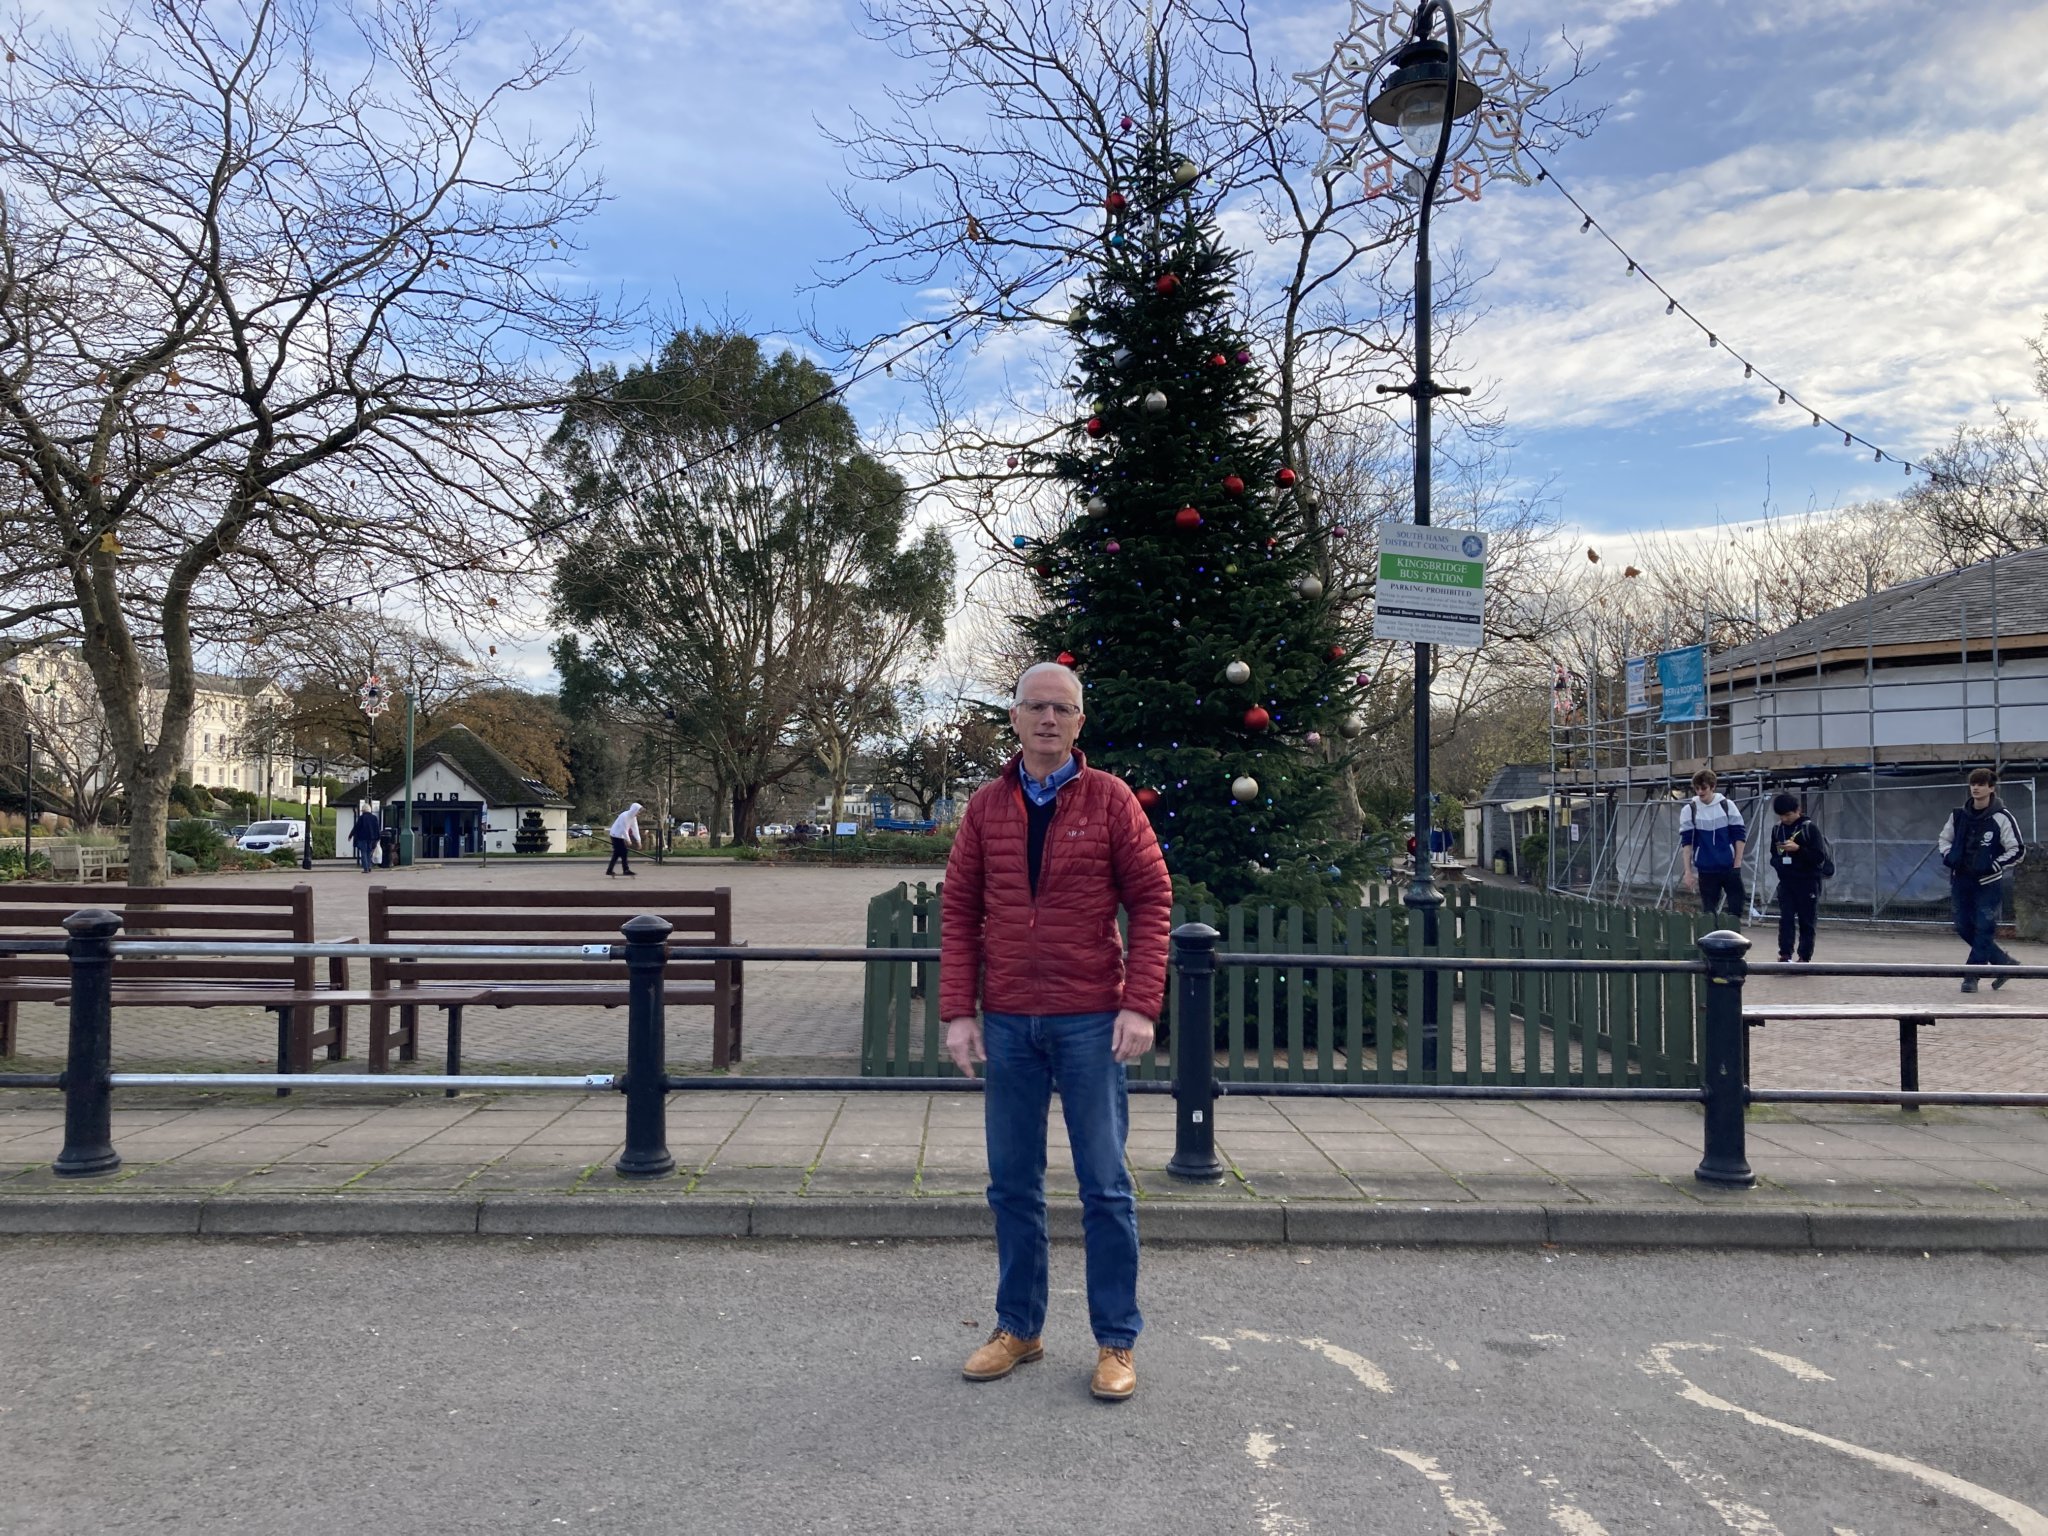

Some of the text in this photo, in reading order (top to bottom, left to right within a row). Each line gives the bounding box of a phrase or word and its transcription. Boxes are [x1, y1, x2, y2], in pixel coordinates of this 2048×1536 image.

[1397, 531, 1449, 543] SOUTH HAMS
[1385, 539, 1459, 552] DISTRICT COUNCIL
[1397, 558, 1468, 573] KINGSBRIDGE
[1400, 569, 1463, 583] BUS STATION
[1391, 584, 1471, 597] PARKING PROHIBITED
